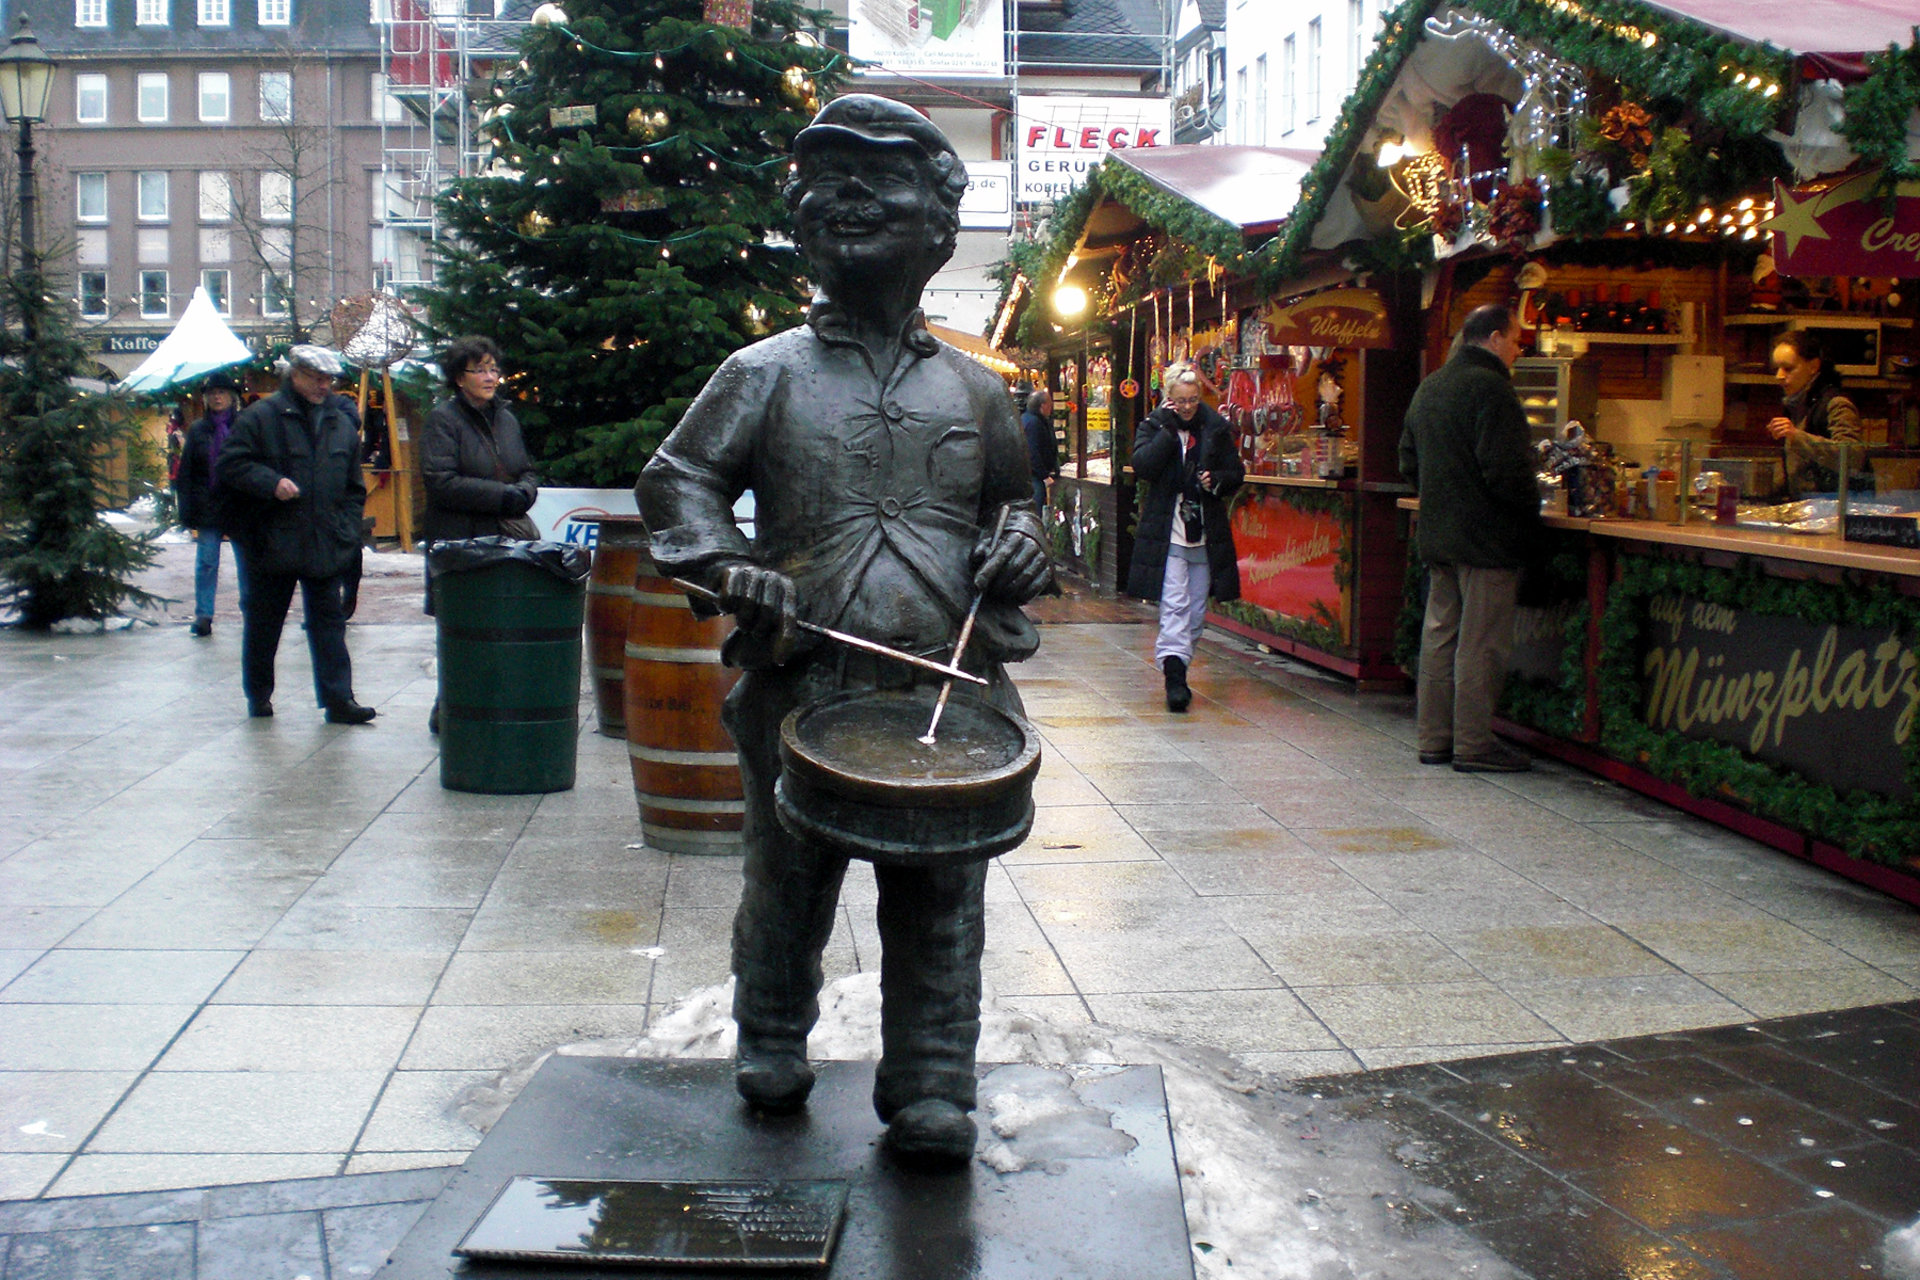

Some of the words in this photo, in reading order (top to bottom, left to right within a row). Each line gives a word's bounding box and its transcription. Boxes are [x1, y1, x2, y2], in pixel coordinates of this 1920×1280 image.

[1026, 126, 1162, 149] FLECK
[1028, 158, 1090, 173] GERÜ
[967, 178, 996, 191] g.de
[1649, 593, 1687, 643] auf
[1644, 623, 1919, 754] Münzplatz
